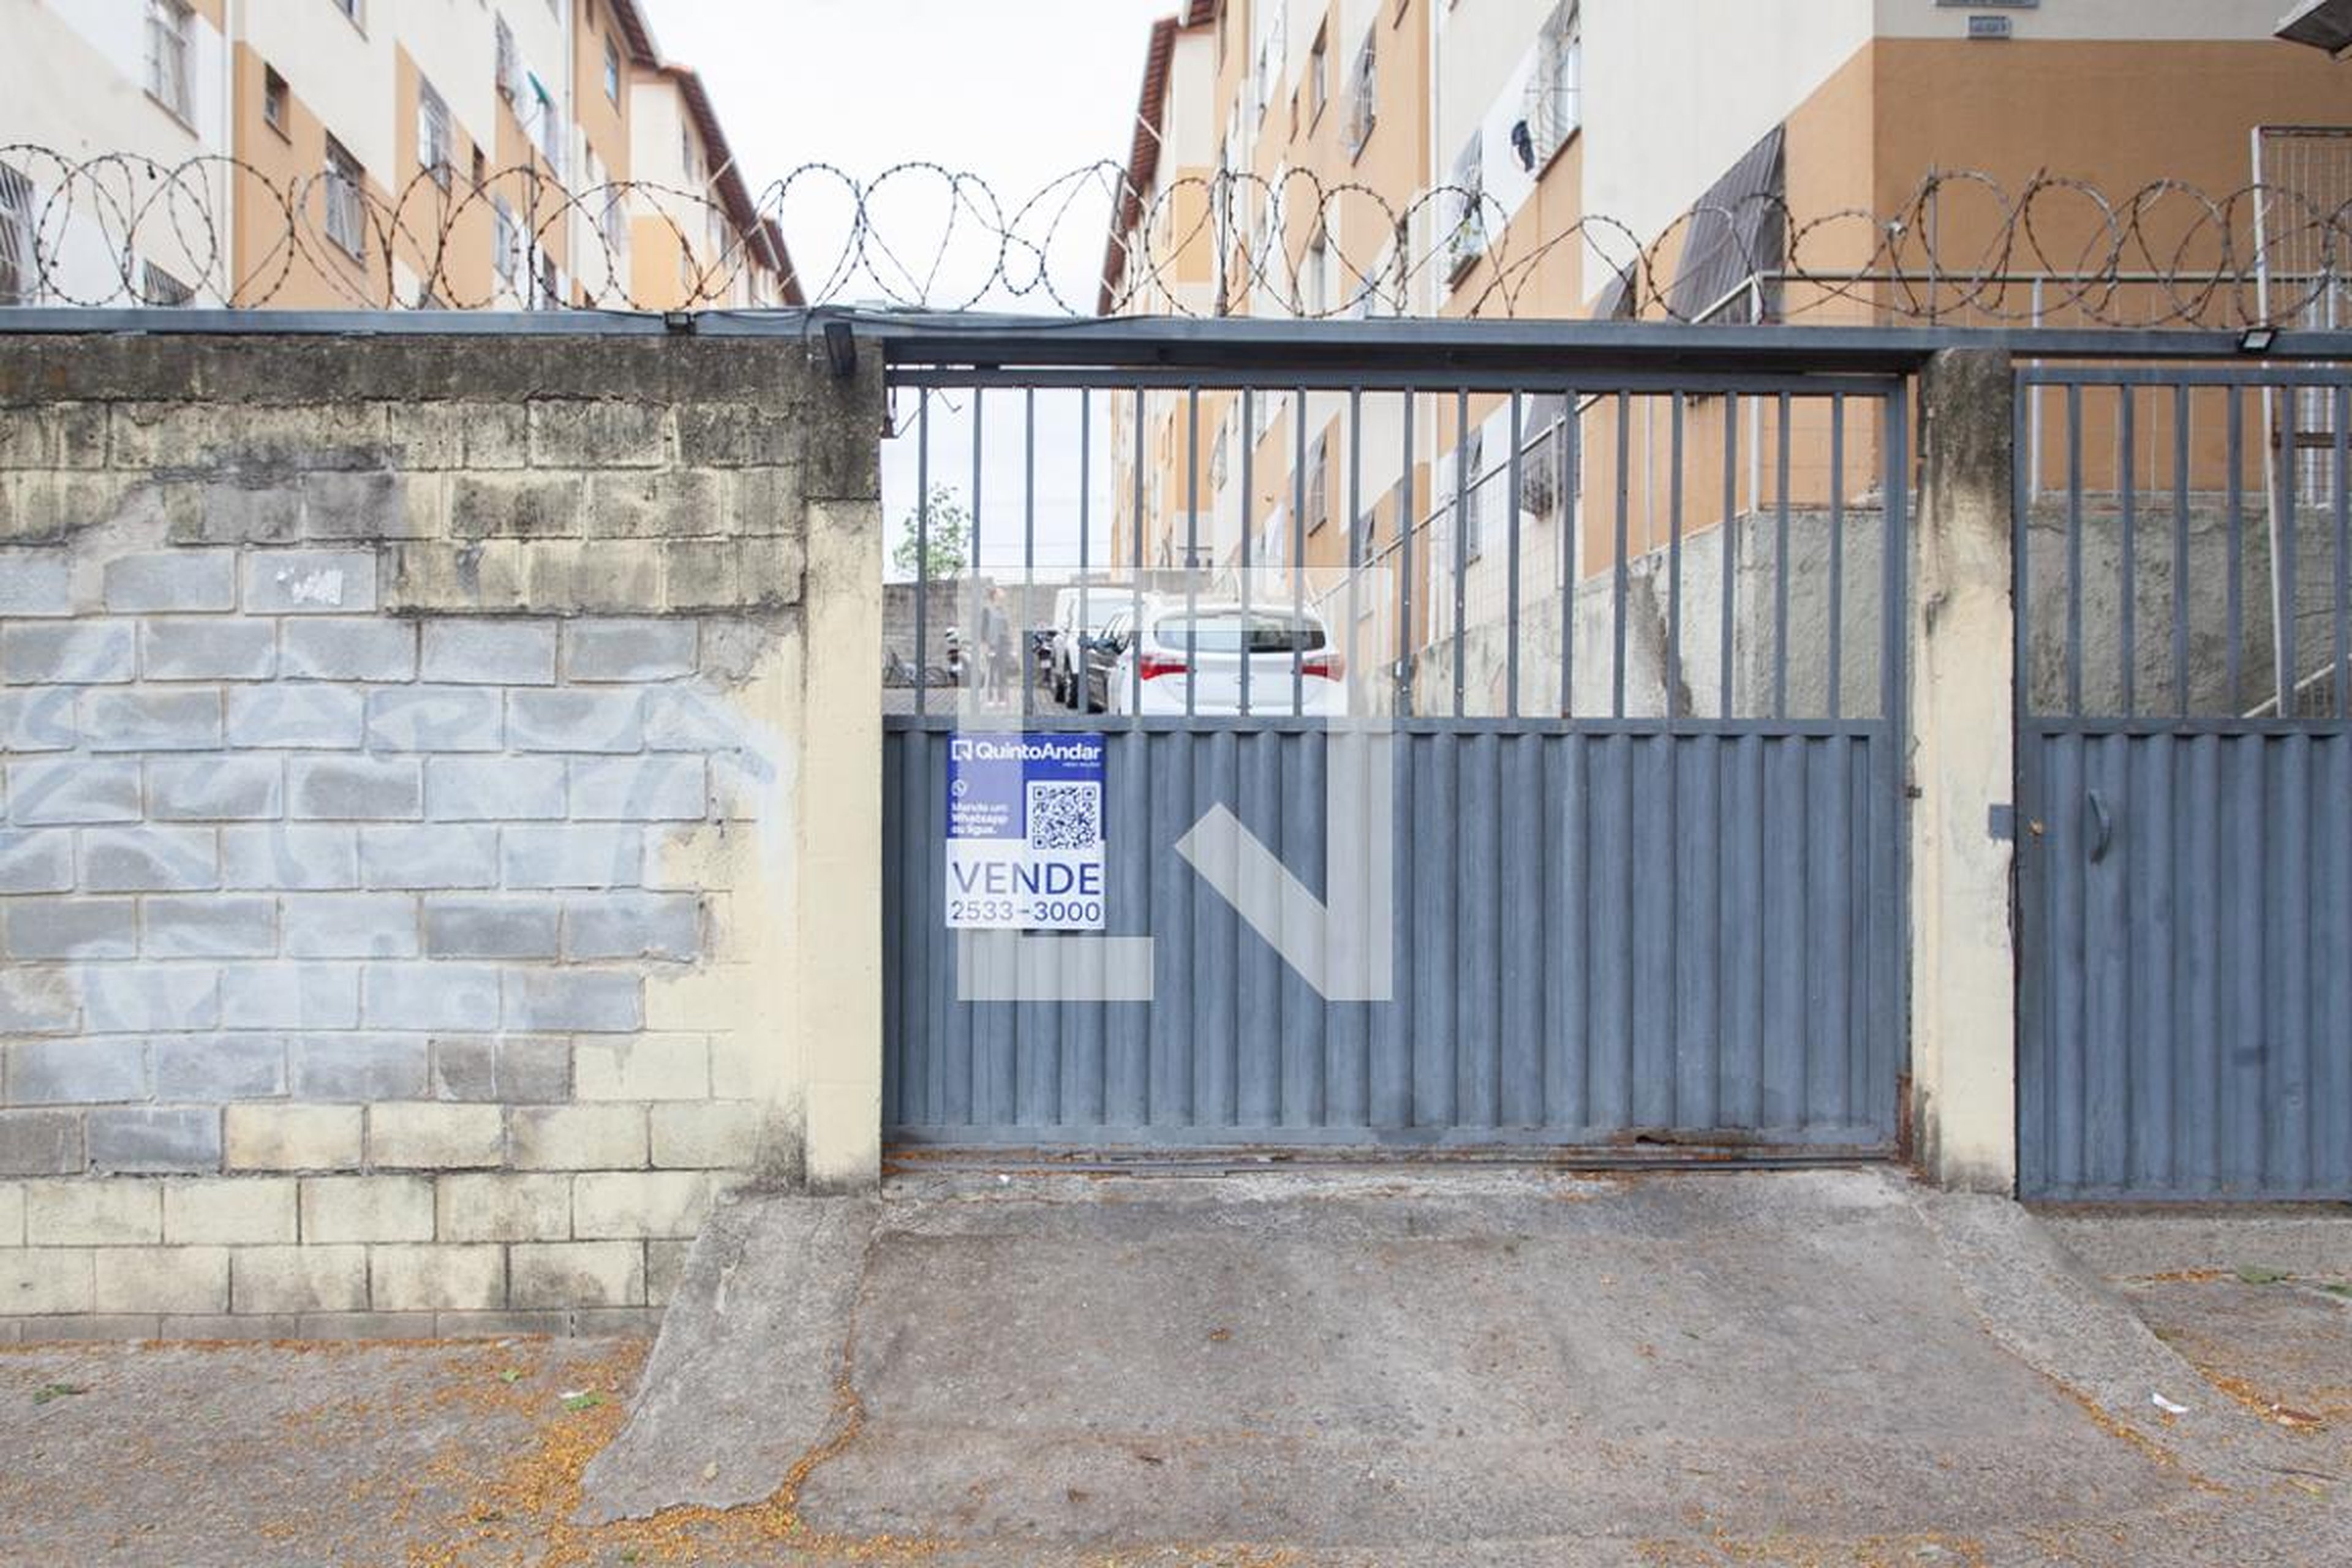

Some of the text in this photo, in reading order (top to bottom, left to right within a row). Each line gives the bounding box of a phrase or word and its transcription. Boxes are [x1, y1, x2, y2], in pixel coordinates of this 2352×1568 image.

[976, 742, 1101, 761] QuintoAndar
[952, 862, 1101, 895] VENDE
[951, 901, 1101, 922] 2533-3000
